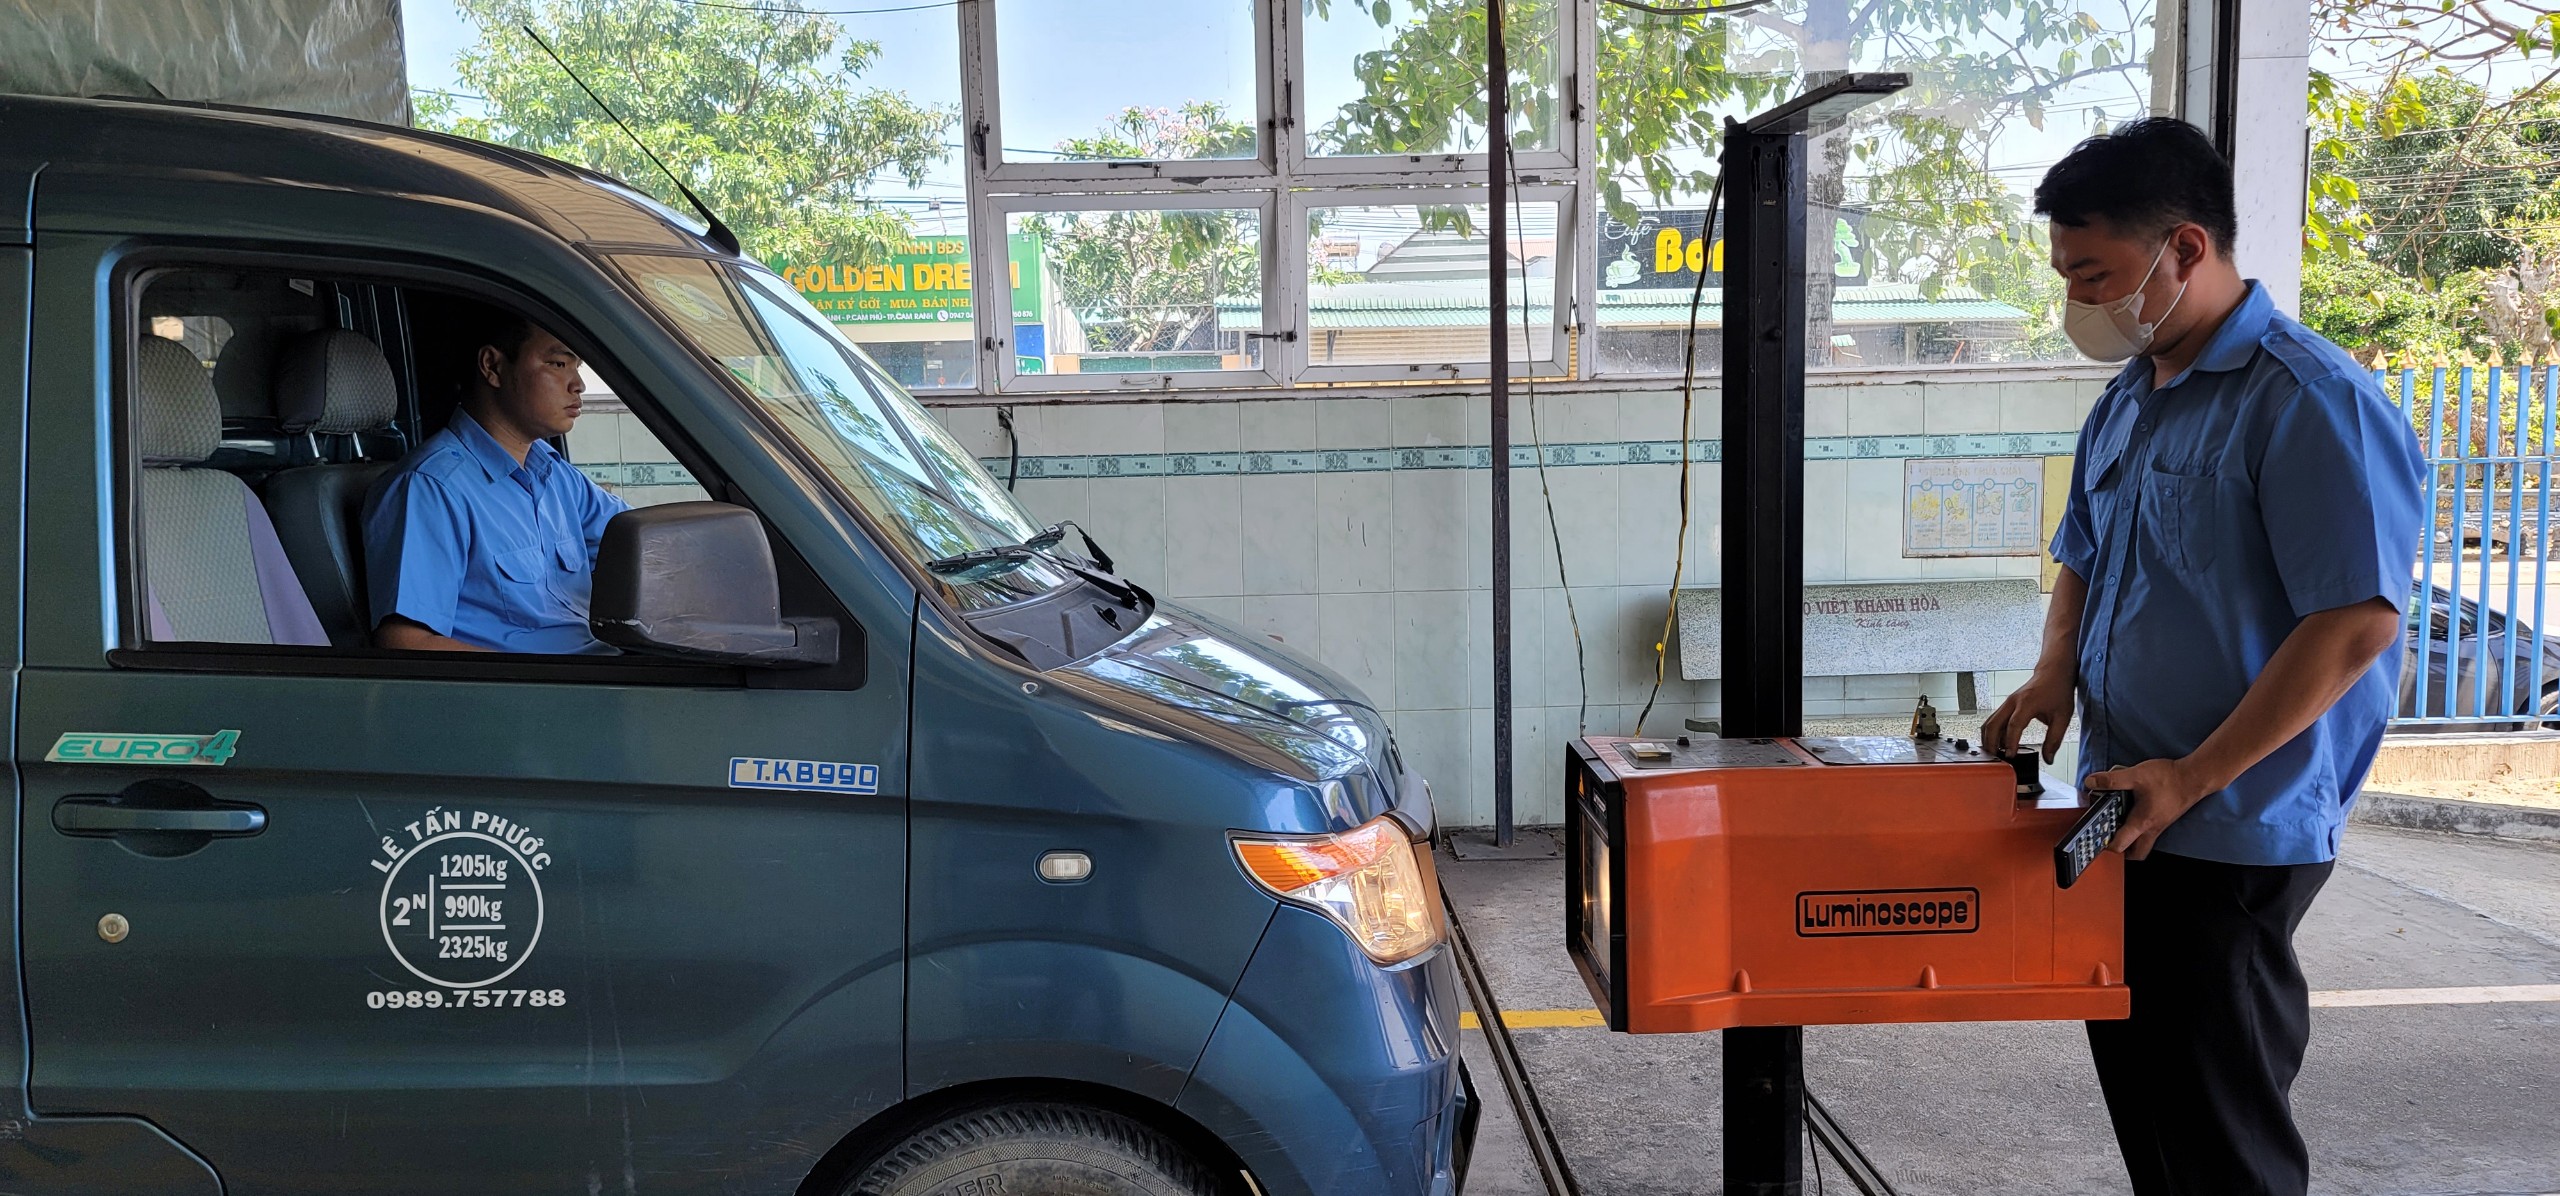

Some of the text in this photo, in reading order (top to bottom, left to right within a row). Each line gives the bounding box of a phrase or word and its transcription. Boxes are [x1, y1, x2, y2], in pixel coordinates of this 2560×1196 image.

[937, 240, 965, 255] BĐS
[783, 264, 906, 293] GOLDEN
[890, 298, 917, 309] MUA
[951, 298, 972, 308] NH
[753, 760, 877, 786] T.KB990
[371, 806, 552, 873] LÊ TẤN PHƯỚC
[440, 854, 508, 881] 1205kg
[444, 895, 502, 921] 990kg
[1804, 897, 1968, 928] Luminoscope
[439, 935, 508, 962] 2325kg
[366, 989, 567, 1009] 0989.757788
